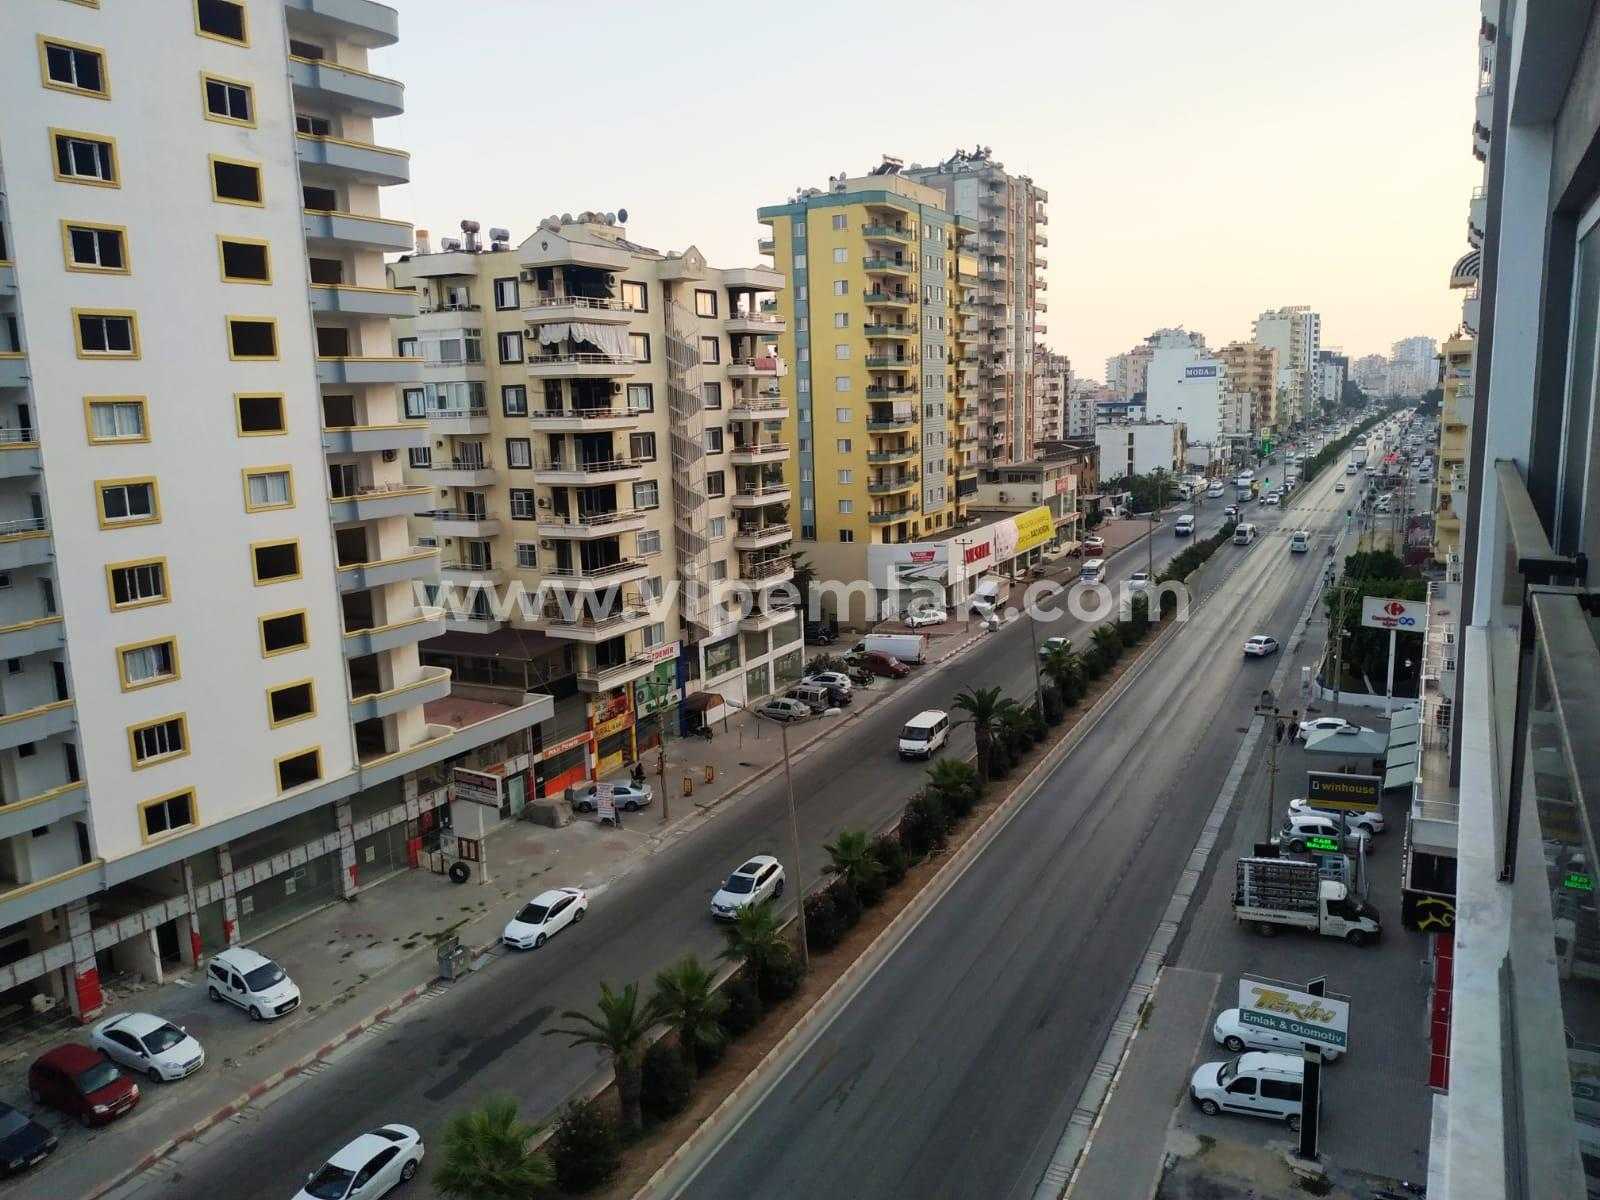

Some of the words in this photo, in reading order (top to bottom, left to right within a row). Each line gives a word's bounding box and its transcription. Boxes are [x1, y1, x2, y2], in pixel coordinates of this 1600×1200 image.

[1321, 783, 1376, 794] winhouse
[1243, 1012, 1278, 1027] Emlak
[1279, 1020, 1289, 1030] &
[1290, 1023, 1343, 1042] Otomotiv
